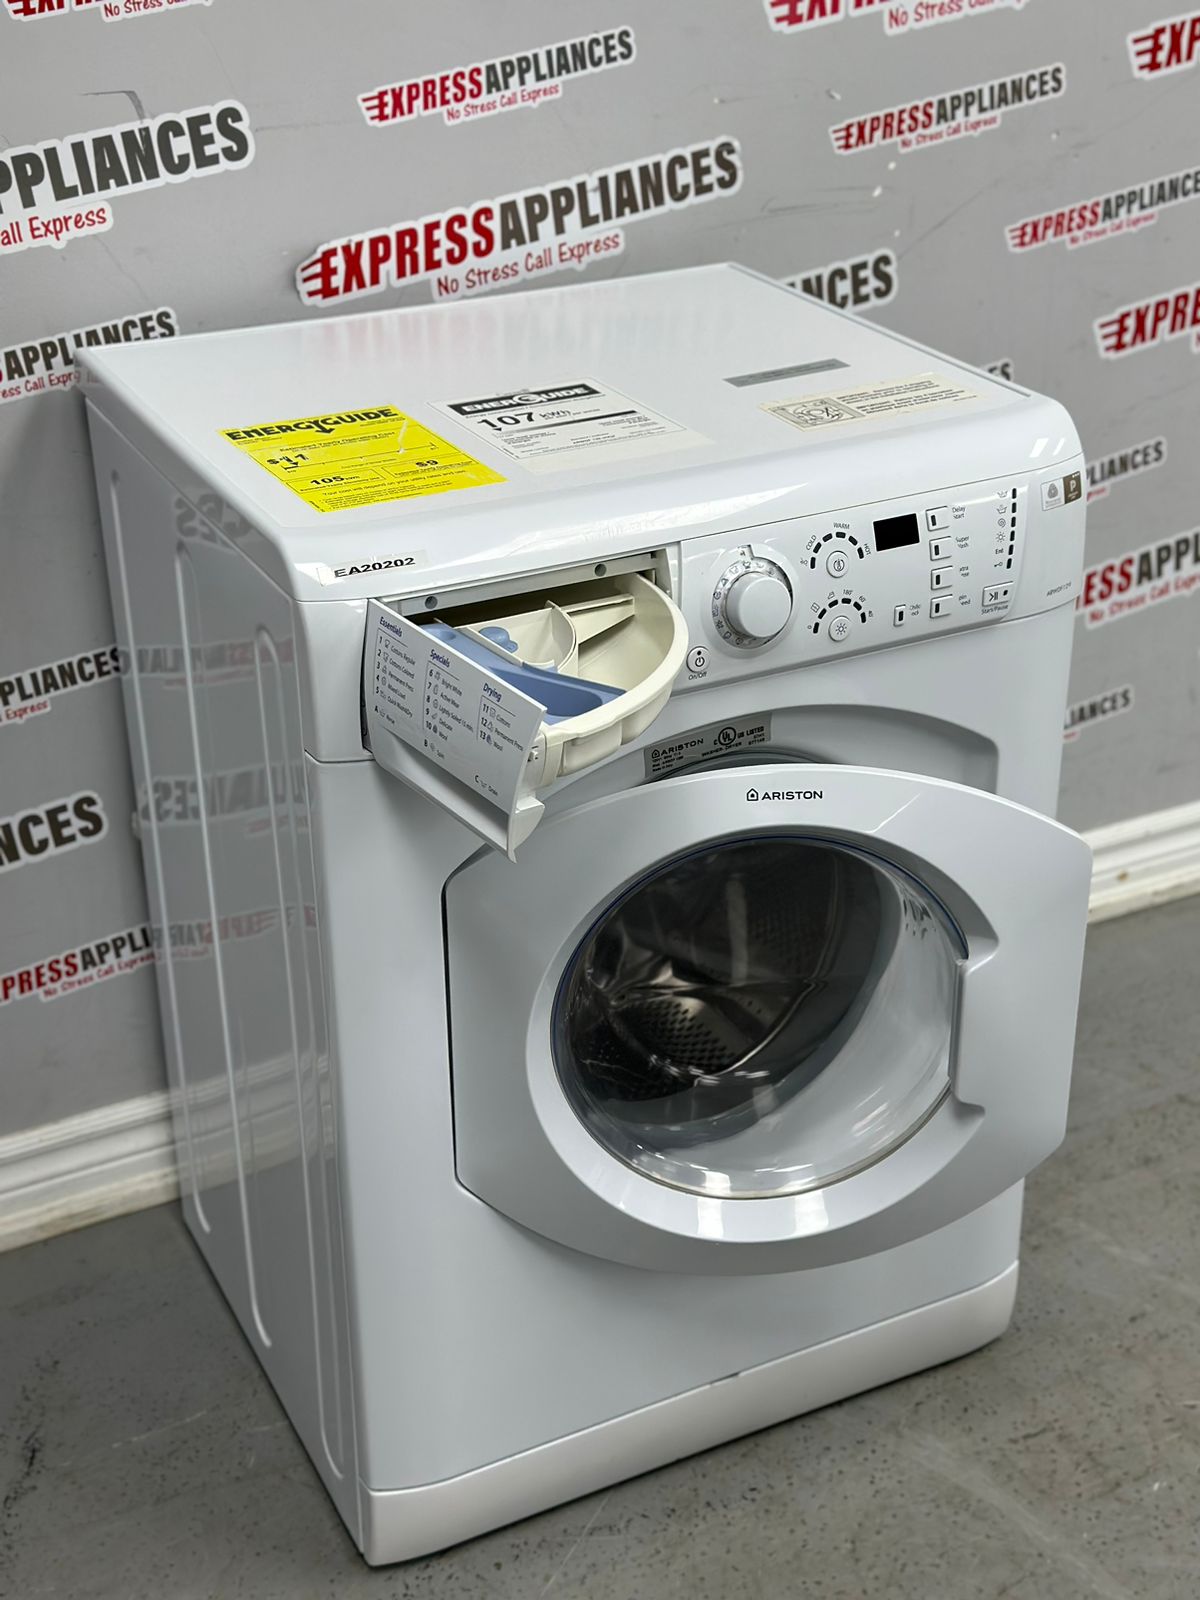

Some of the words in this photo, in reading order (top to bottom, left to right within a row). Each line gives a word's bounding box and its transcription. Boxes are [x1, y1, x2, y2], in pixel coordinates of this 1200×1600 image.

[104, 4, 120, 18] No
[889, 10, 908, 29] No
[914, 2, 962, 22] Stress
[446, 106, 461, 121] No
[463, 100, 498, 118] Stress
[500, 94, 518, 108] Call
[520, 83, 559, 104] Express
[28, 207, 107, 241] Express
[437, 274, 459, 296] No
[465, 261, 518, 290] Stress
[525, 249, 552, 274] Call
[558, 233, 620, 270] Express
[786, 254, 893, 309] NCES
[25, 376, 46, 392] Call
[477, 412, 535, 428] 107
[310, 475, 345, 485] 105
[833, 522, 850, 530] WARM
[805, 534, 817, 551] COLD
[334, 557, 416, 578] EA20202
[379, 616, 403, 638] Essentials
[429, 648, 450, 668] Specials
[482, 682, 502, 703] Drying
[482, 703, 489, 713] 11
[660, 738, 704, 757] ARISTON
[761, 790, 823, 801] ARISTON
